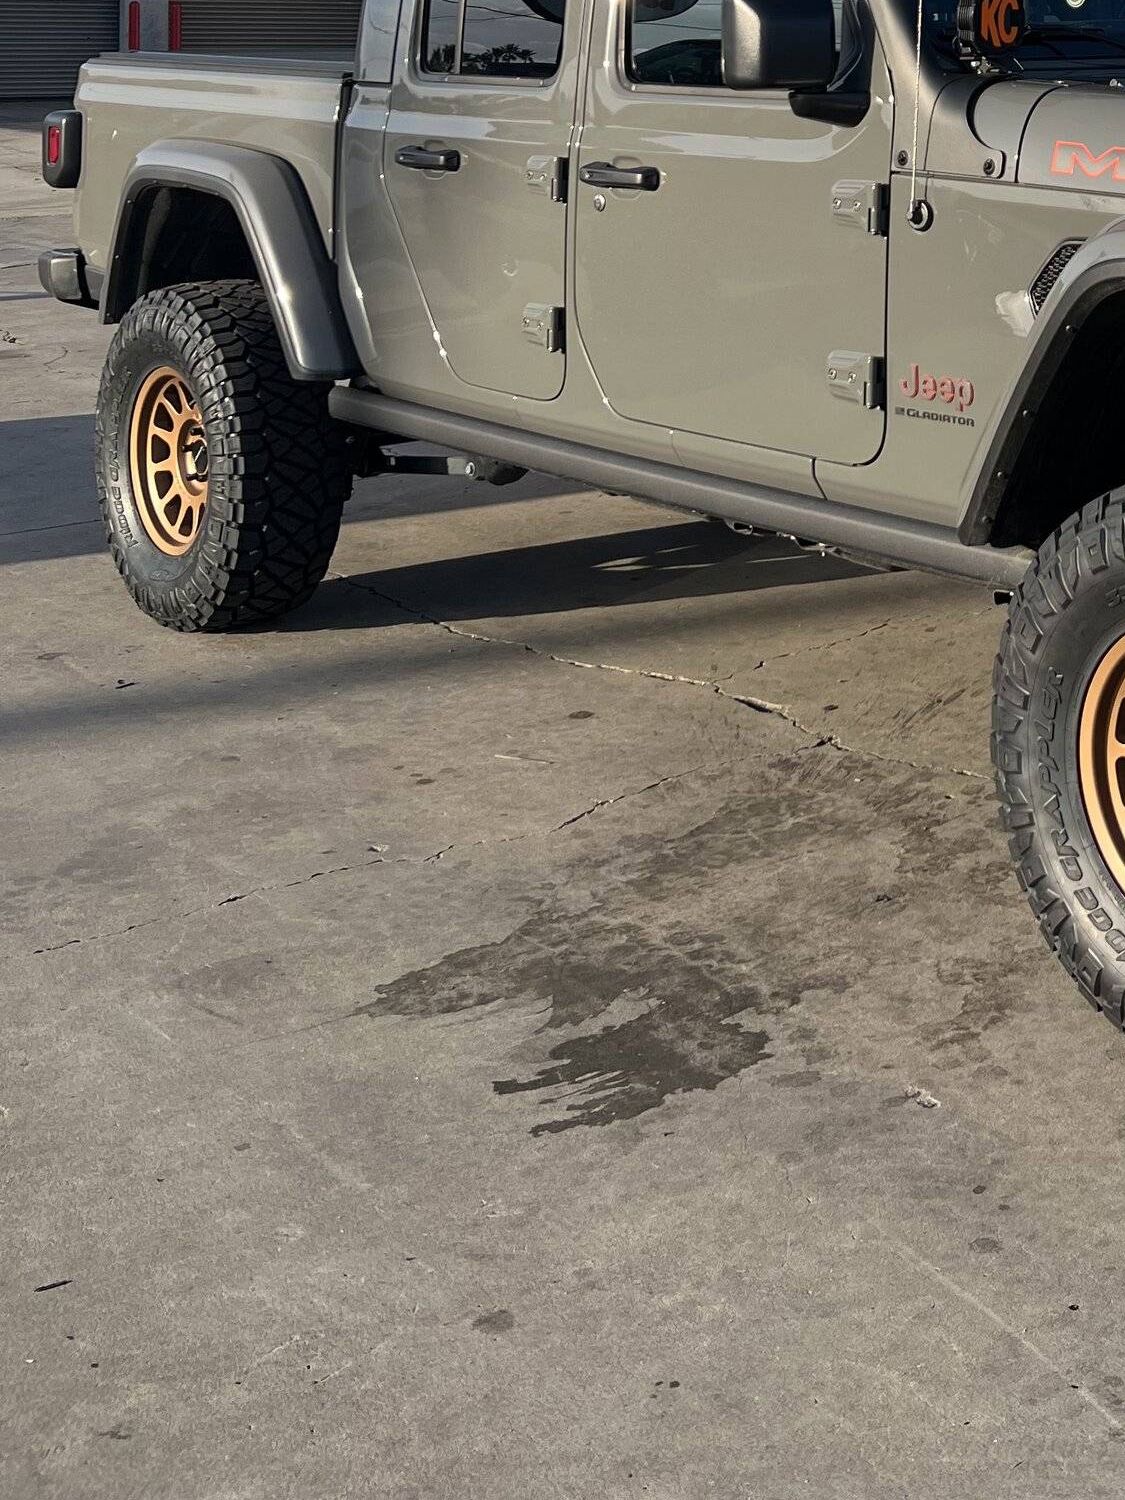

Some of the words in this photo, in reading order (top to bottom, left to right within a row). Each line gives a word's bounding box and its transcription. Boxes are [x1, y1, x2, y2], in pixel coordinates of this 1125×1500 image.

[898, 363, 976, 413] Jeep
[906, 408, 976, 428] GLADIATOR
[1034, 666, 1083, 882] GRAPPLER
